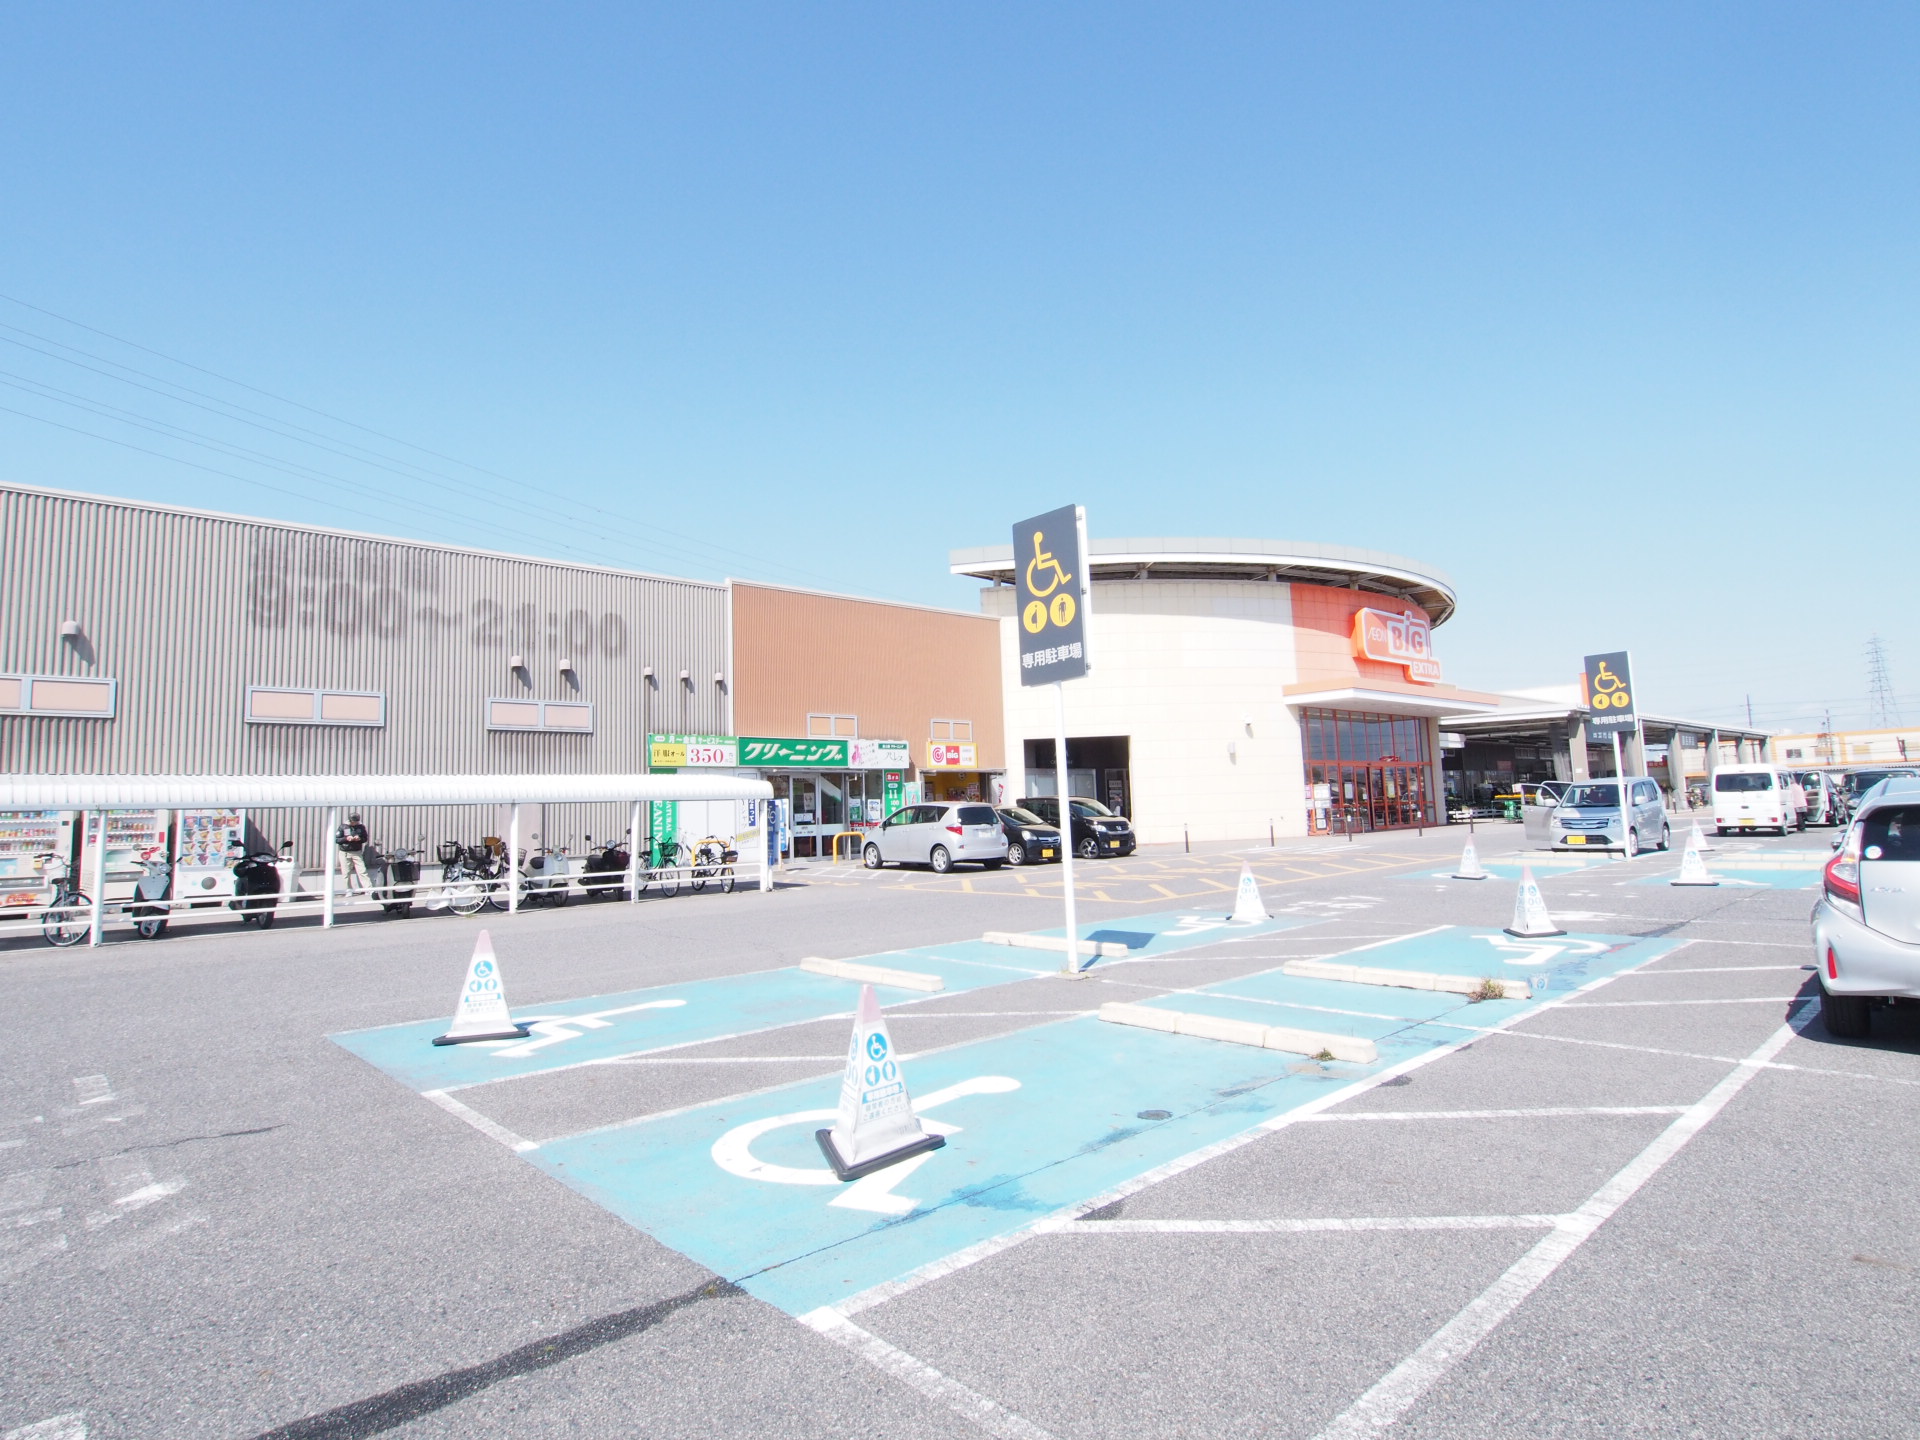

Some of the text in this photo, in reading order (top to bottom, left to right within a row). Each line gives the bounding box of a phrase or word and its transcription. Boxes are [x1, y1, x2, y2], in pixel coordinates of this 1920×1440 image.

[1022, 642, 1082, 668] 専用駐車場
[690, 748, 724, 764] 350
